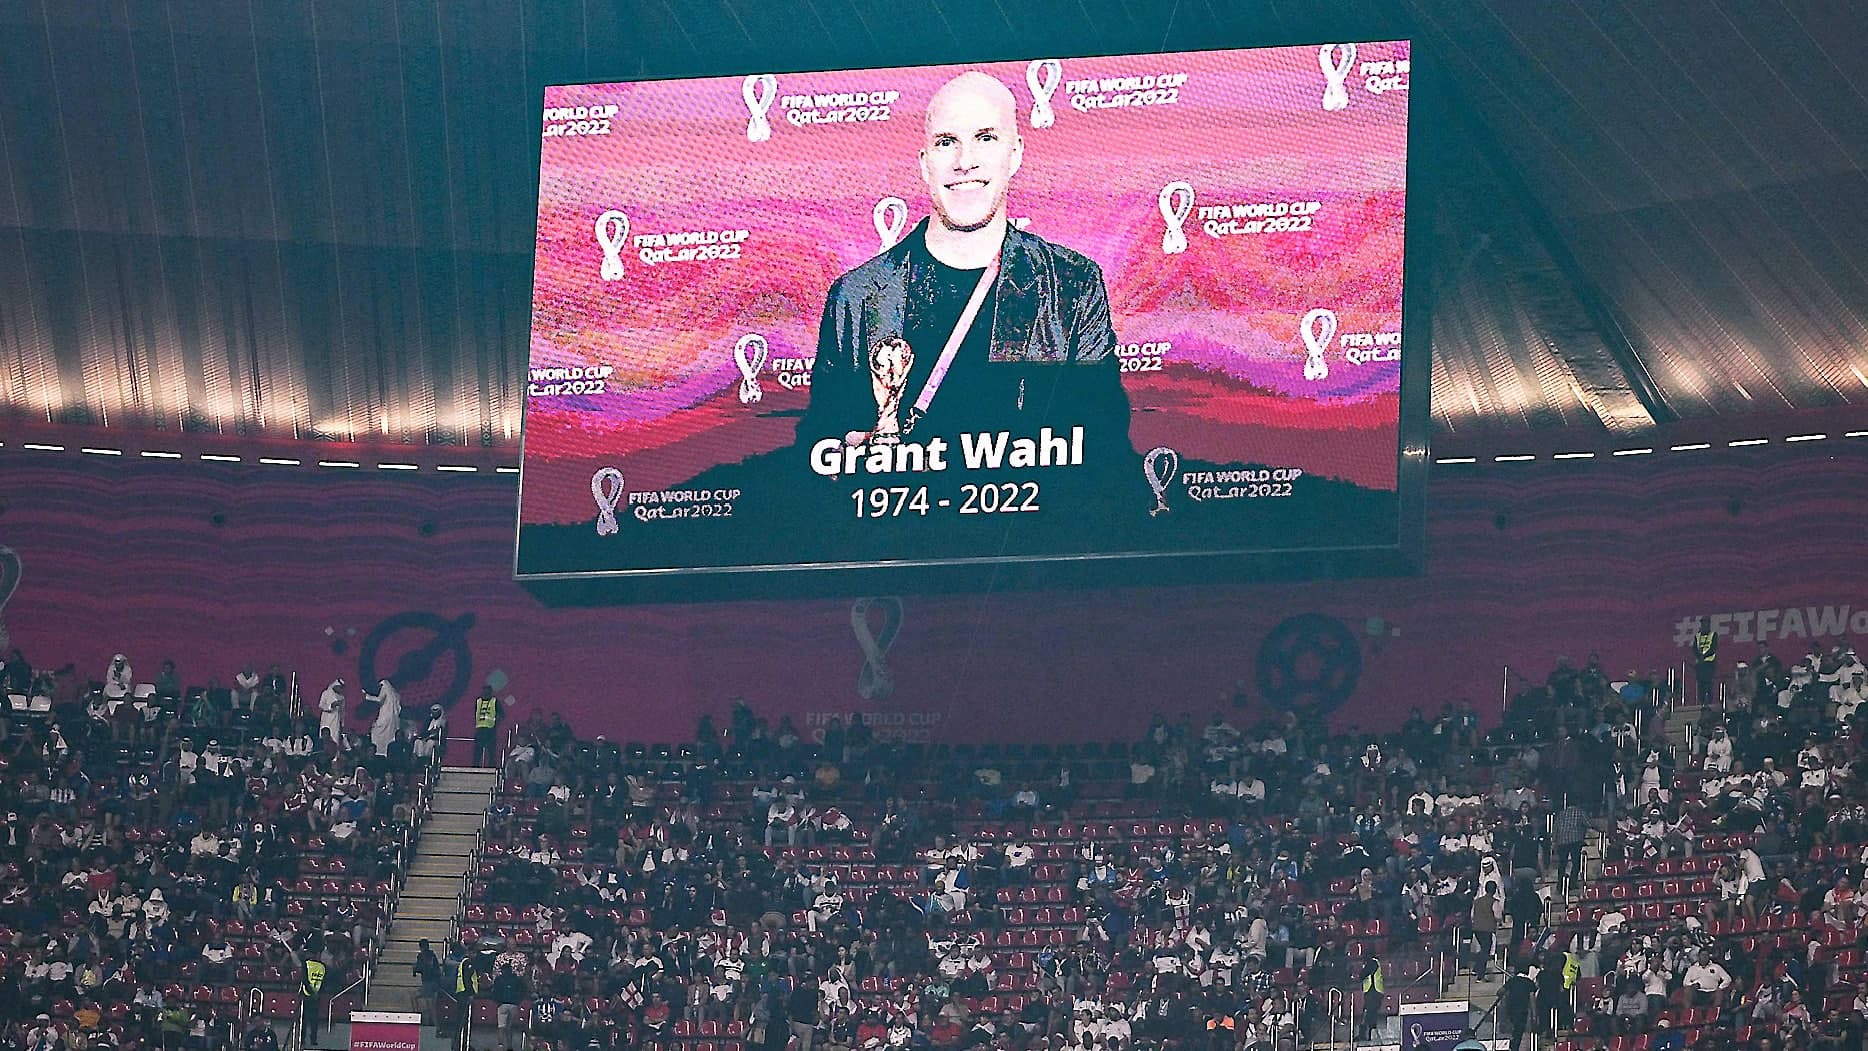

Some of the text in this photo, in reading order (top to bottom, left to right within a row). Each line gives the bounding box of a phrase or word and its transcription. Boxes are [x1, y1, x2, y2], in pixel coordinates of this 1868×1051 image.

[1360, 61, 1396, 76] FIFA
[1065, 72, 1188, 94] FIFA WORLD CUP
[781, 90, 900, 109] FIFA WORLD CUP
[589, 104, 619, 119] CUP
[1198, 200, 1322, 219] FIFA WORLD CUP
[633, 229, 750, 248] FIFA WORLD CUP
[1141, 341, 1172, 356] CUP
[1340, 333, 1374, 348] FIFA
[772, 358, 804, 371] FIFA
[530, 365, 614, 381] WORLD CUP
[809, 426, 1085, 477] Grant Wahl
[1182, 468, 1303, 485] FIFA WORLD CUP
[628, 489, 741, 505] FIFA WORLD CUP
[851, 482, 1041, 518] 1974 - 2022
[1672, 605, 1868, 647] #FIFAWo
[908, 711, 942, 726] CUP
[353, 1040, 416, 1051] #FIFAWorldCup
